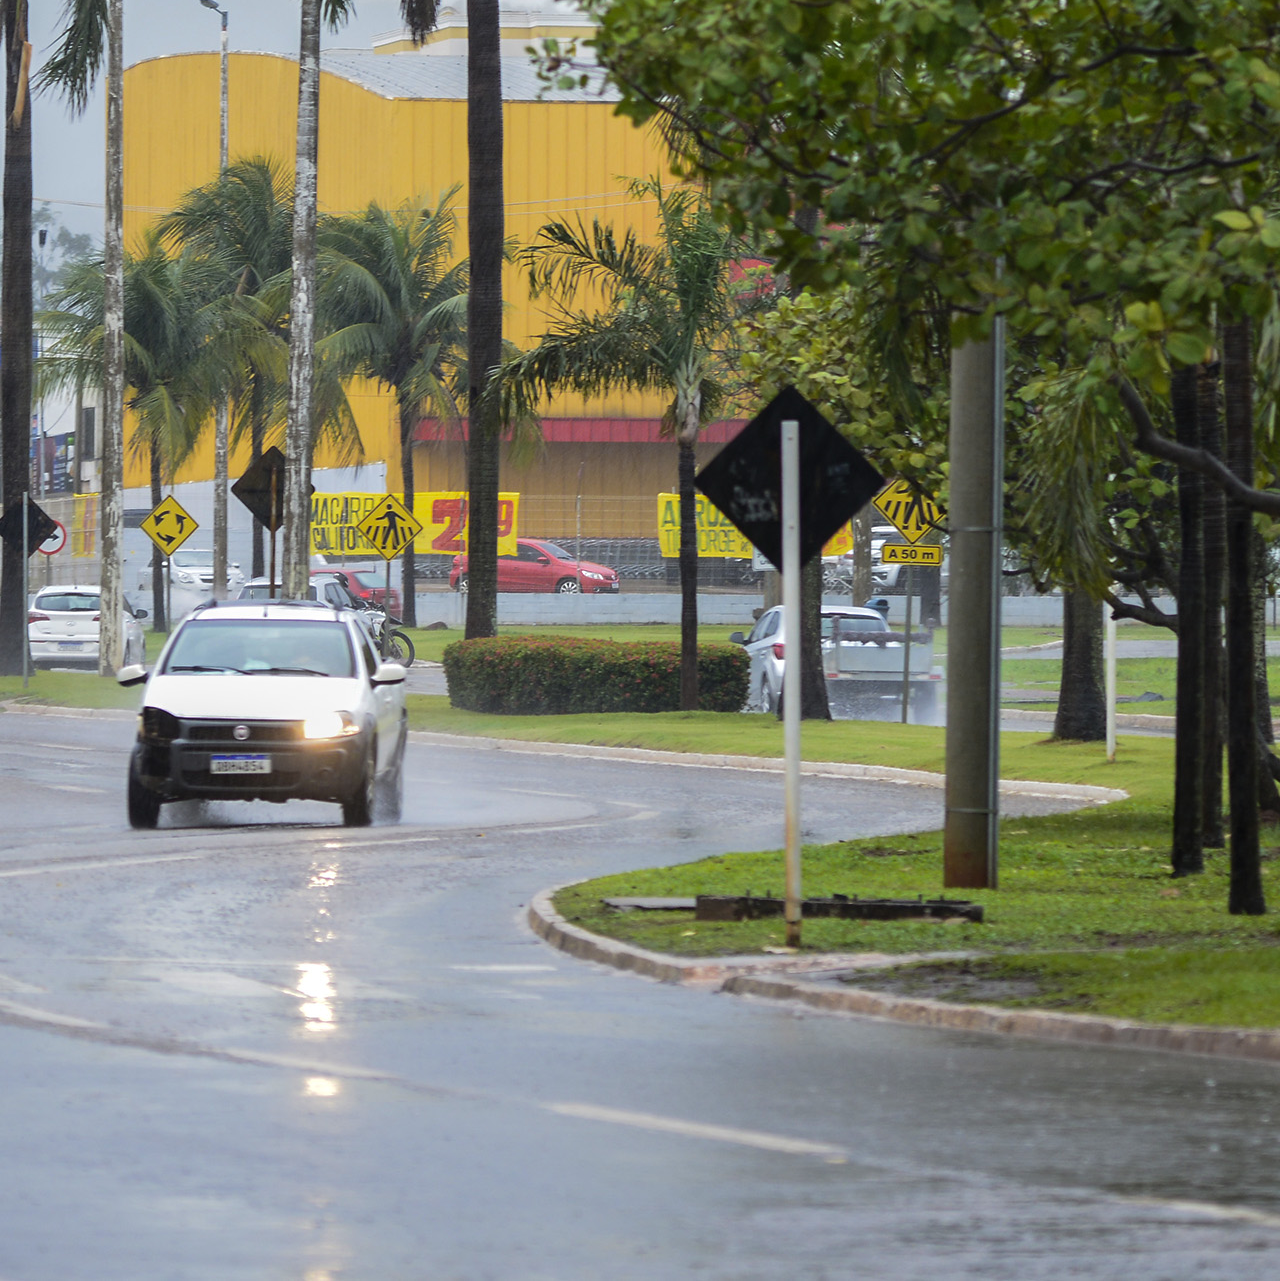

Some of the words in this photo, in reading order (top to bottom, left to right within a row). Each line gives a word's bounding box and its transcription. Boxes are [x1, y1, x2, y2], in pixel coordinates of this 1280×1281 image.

[309, 497, 400, 525] MACARR
[312, 526, 376, 551] CALIFOR
[695, 529, 736, 554] ORGE
[888, 548, 898, 559] A
[901, 549, 918, 560] 50
[922, 551, 935, 560] m
